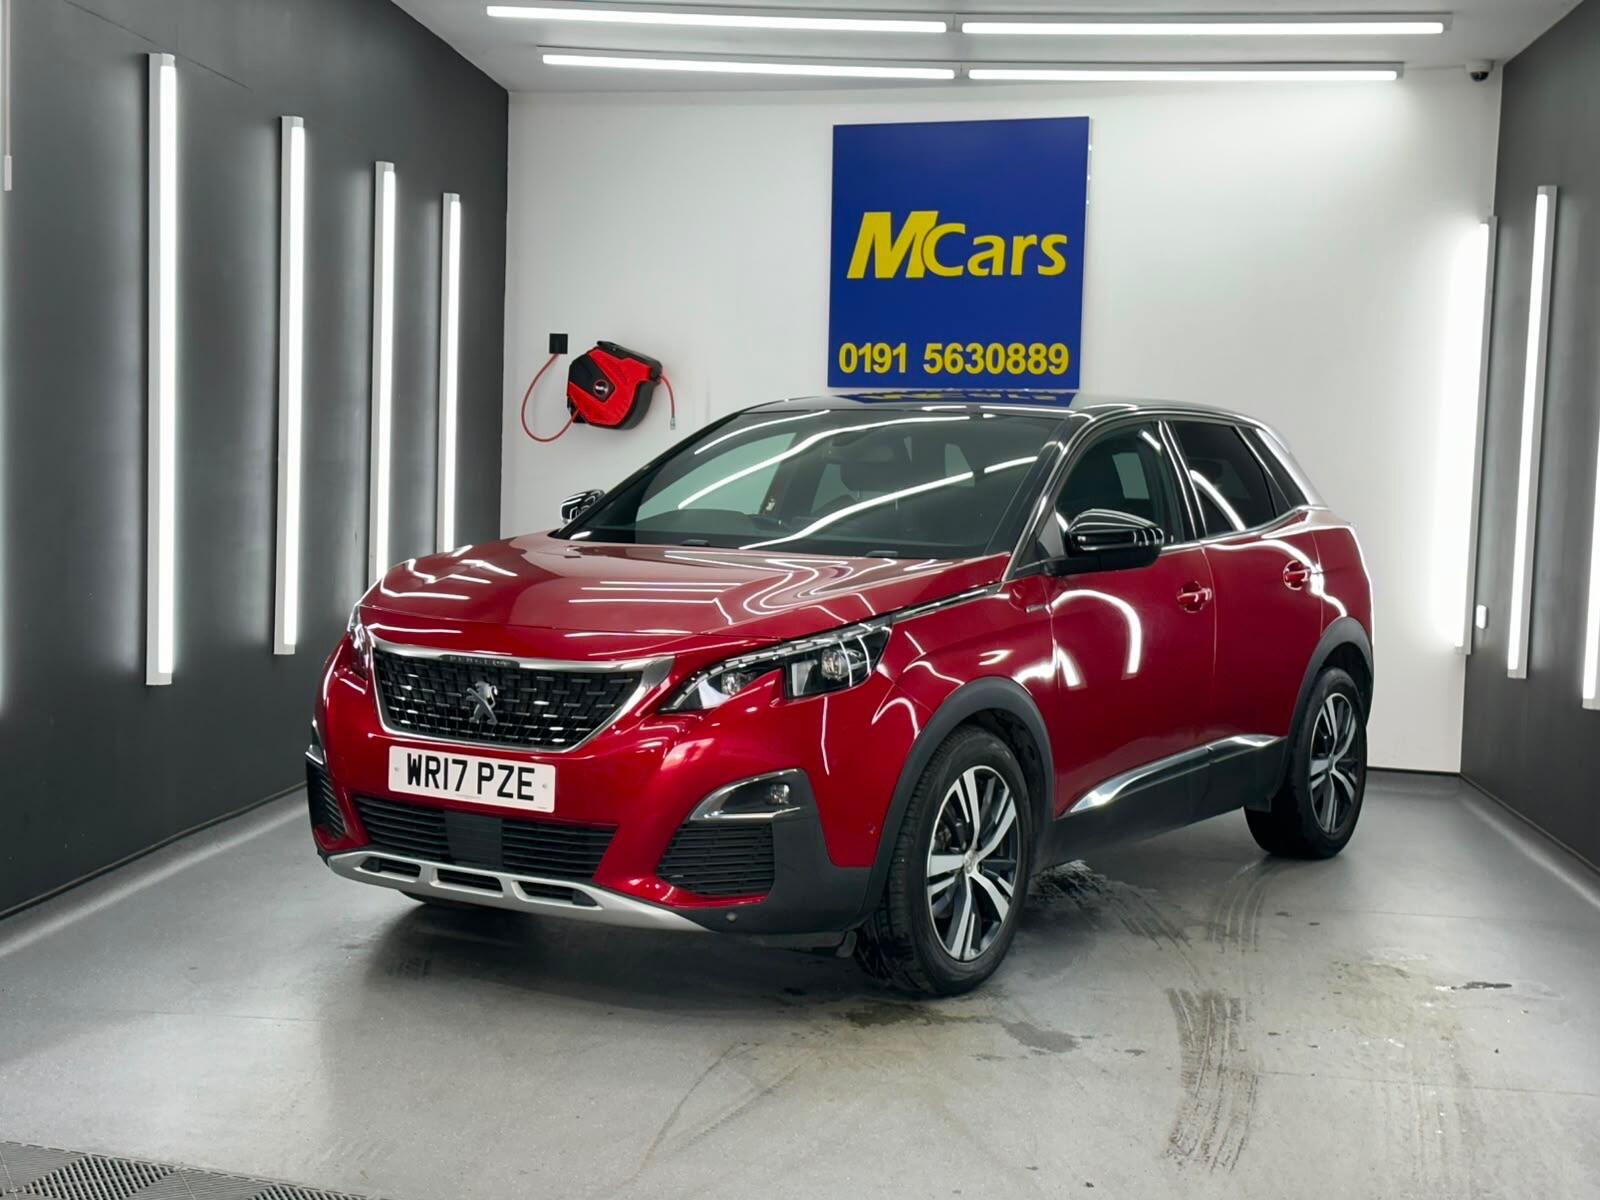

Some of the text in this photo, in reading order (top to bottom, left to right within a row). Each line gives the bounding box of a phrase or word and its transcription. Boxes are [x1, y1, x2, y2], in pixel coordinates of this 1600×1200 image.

[847, 210, 1068, 279] MCars
[838, 342, 1069, 375] 0191 5630889
[407, 753, 535, 801] WR17 PZE
